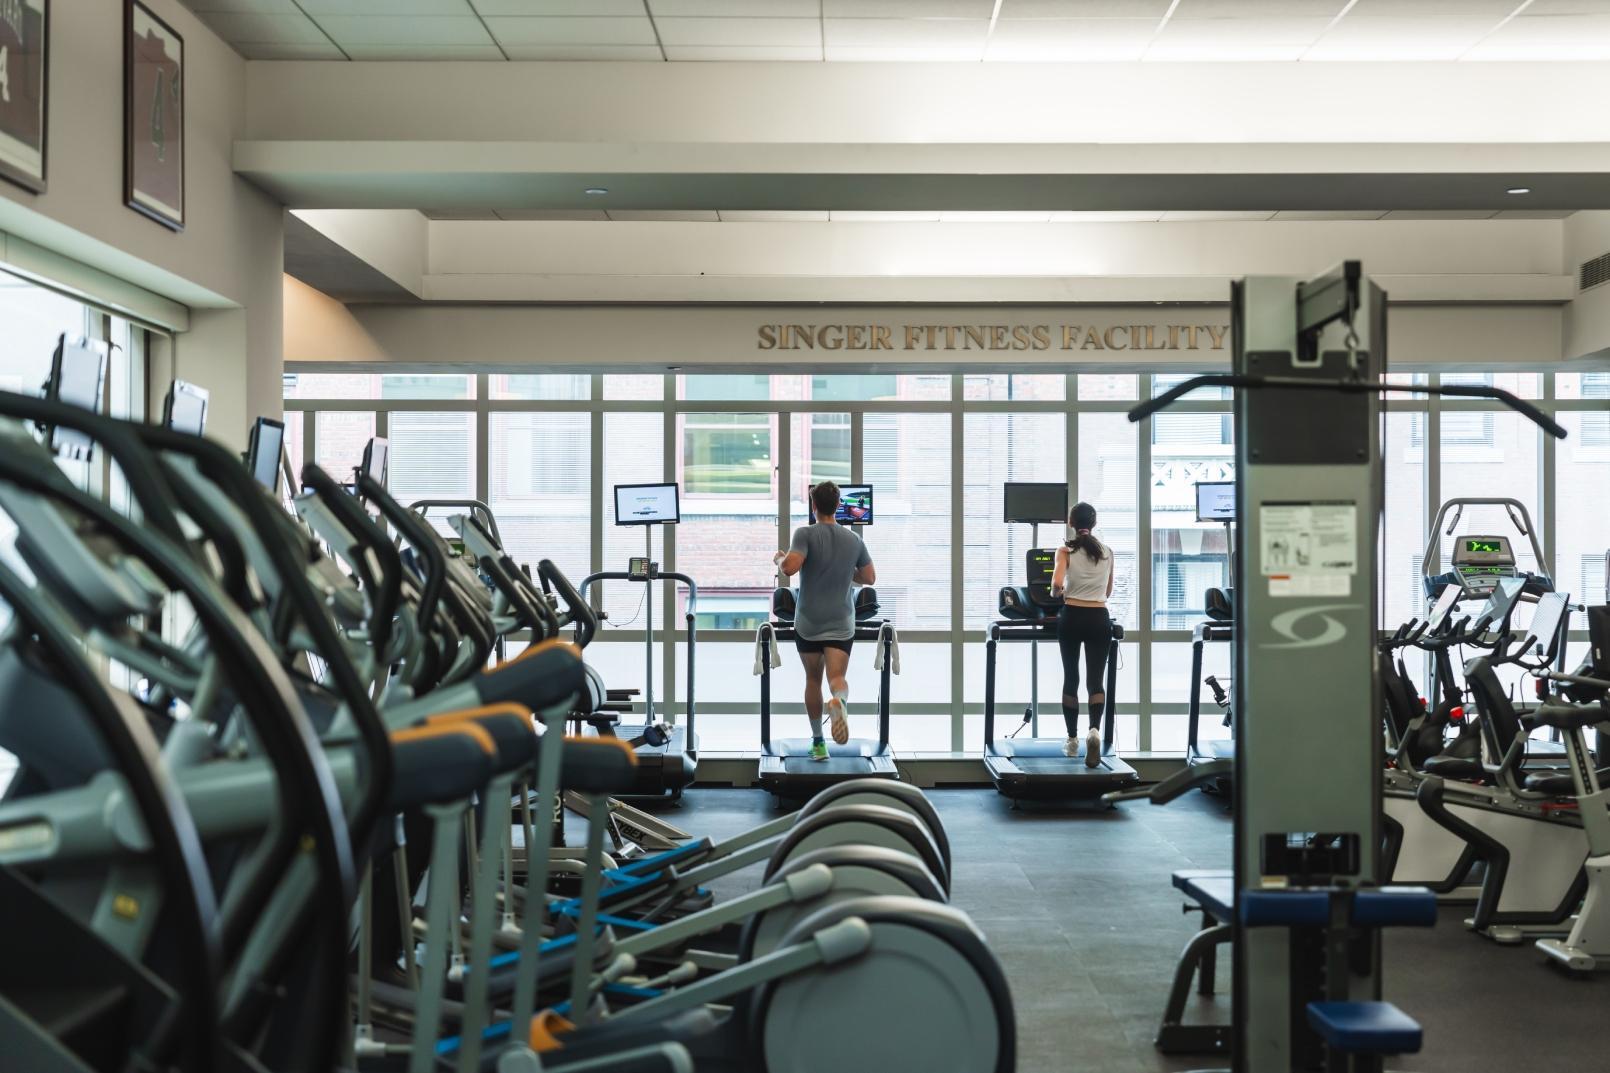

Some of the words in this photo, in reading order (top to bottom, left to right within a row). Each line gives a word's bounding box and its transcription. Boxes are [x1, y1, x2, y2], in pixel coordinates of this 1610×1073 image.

[757, 324, 894, 350] SINGER
[903, 324, 1051, 350] FITNESS
[1060, 324, 1230, 350] FACILITY
